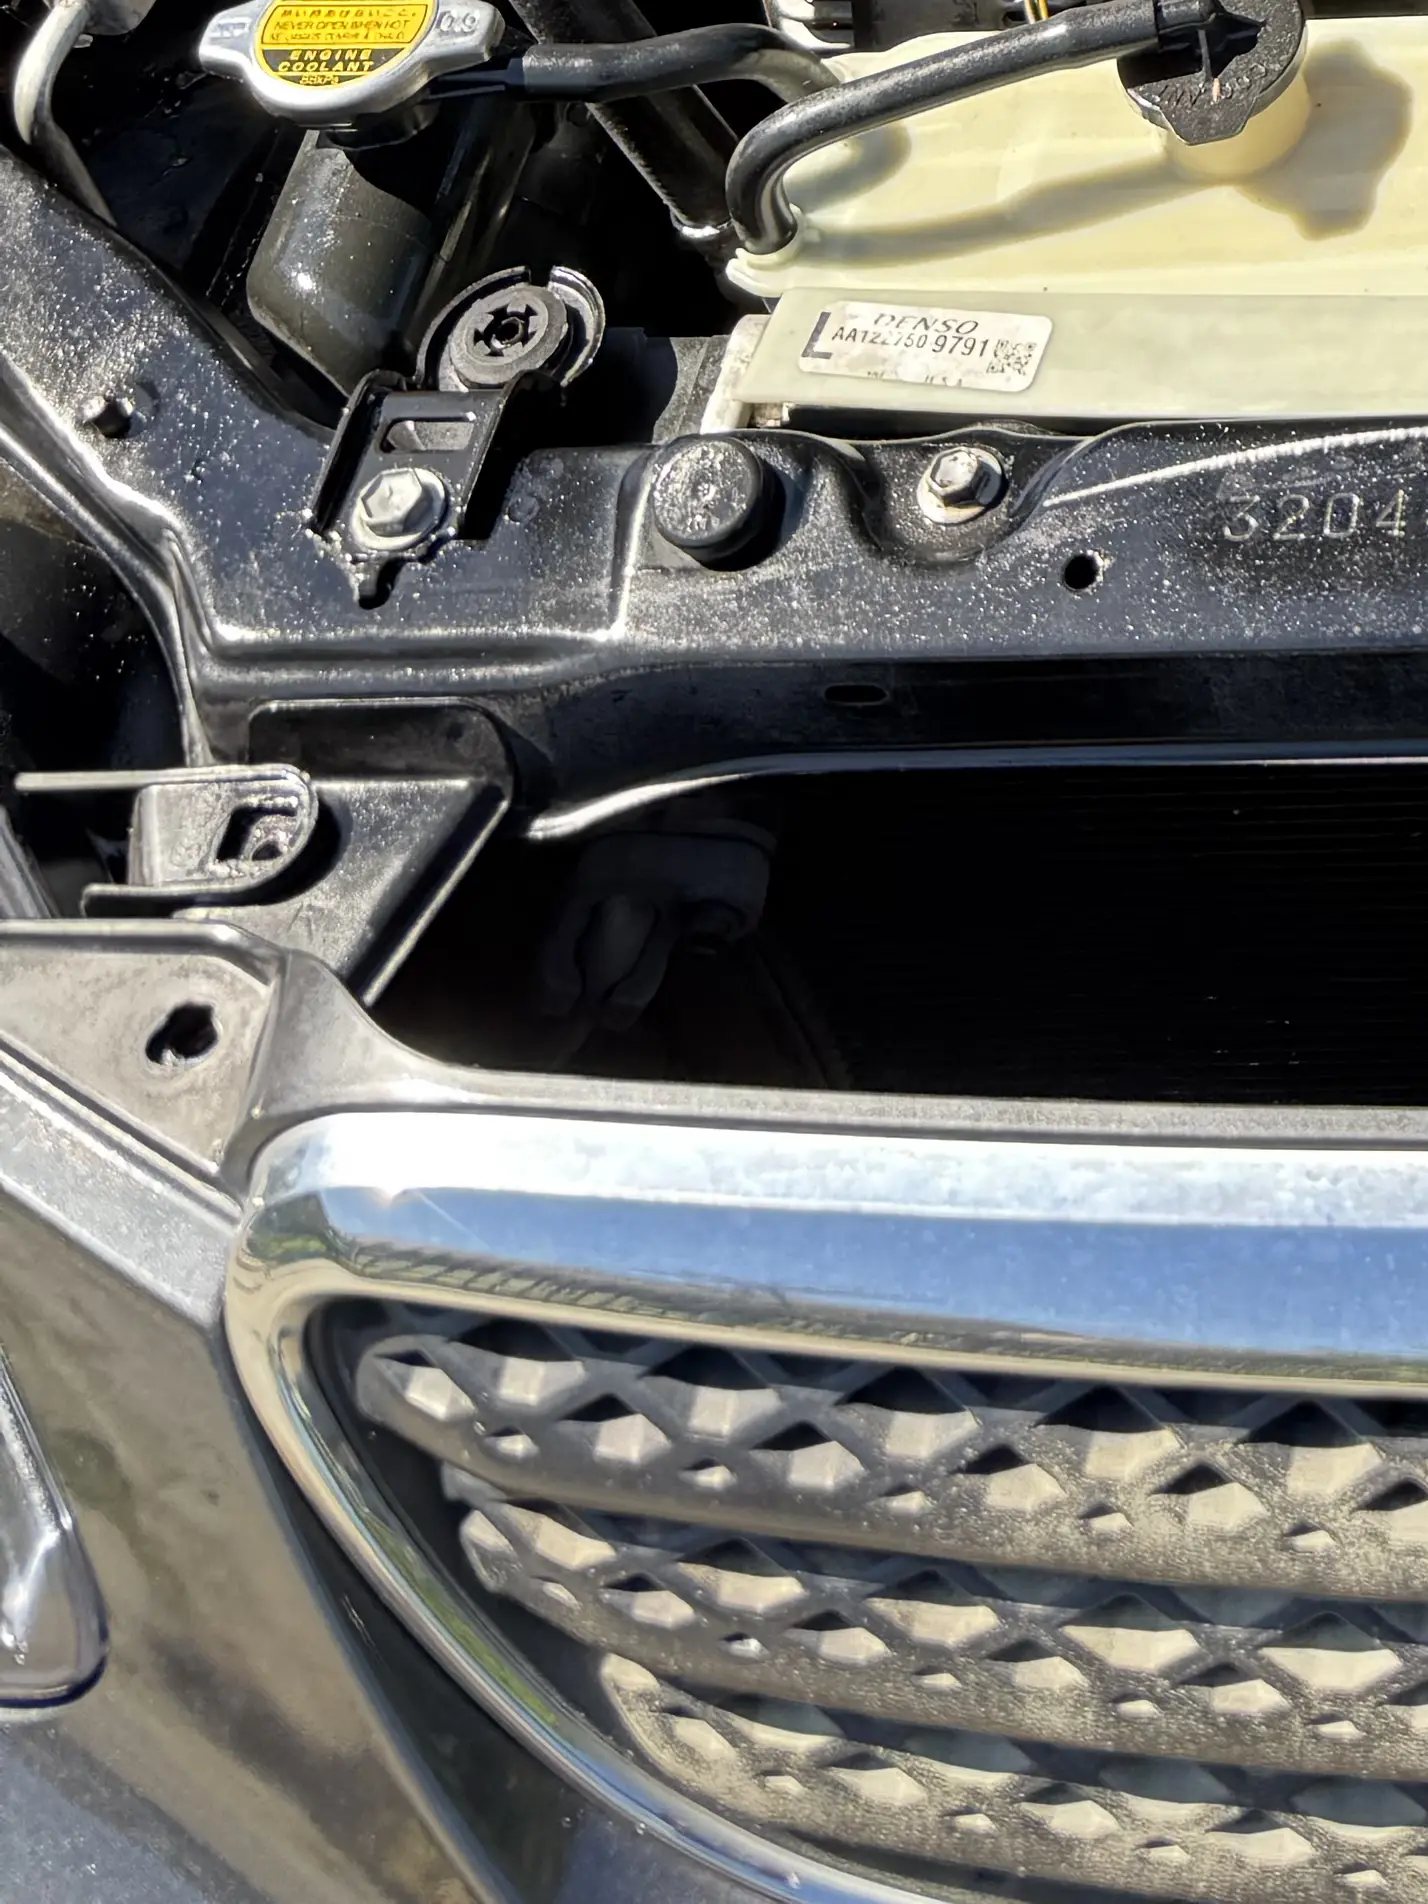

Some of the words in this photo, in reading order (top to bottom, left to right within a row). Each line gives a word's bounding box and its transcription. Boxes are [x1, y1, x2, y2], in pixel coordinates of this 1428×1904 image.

[289, 49, 373, 61] ENGINE
[277, 61, 375, 73] COOLANT
[873, 312, 980, 335] DENSO
[931, 333, 990, 358] 9791
